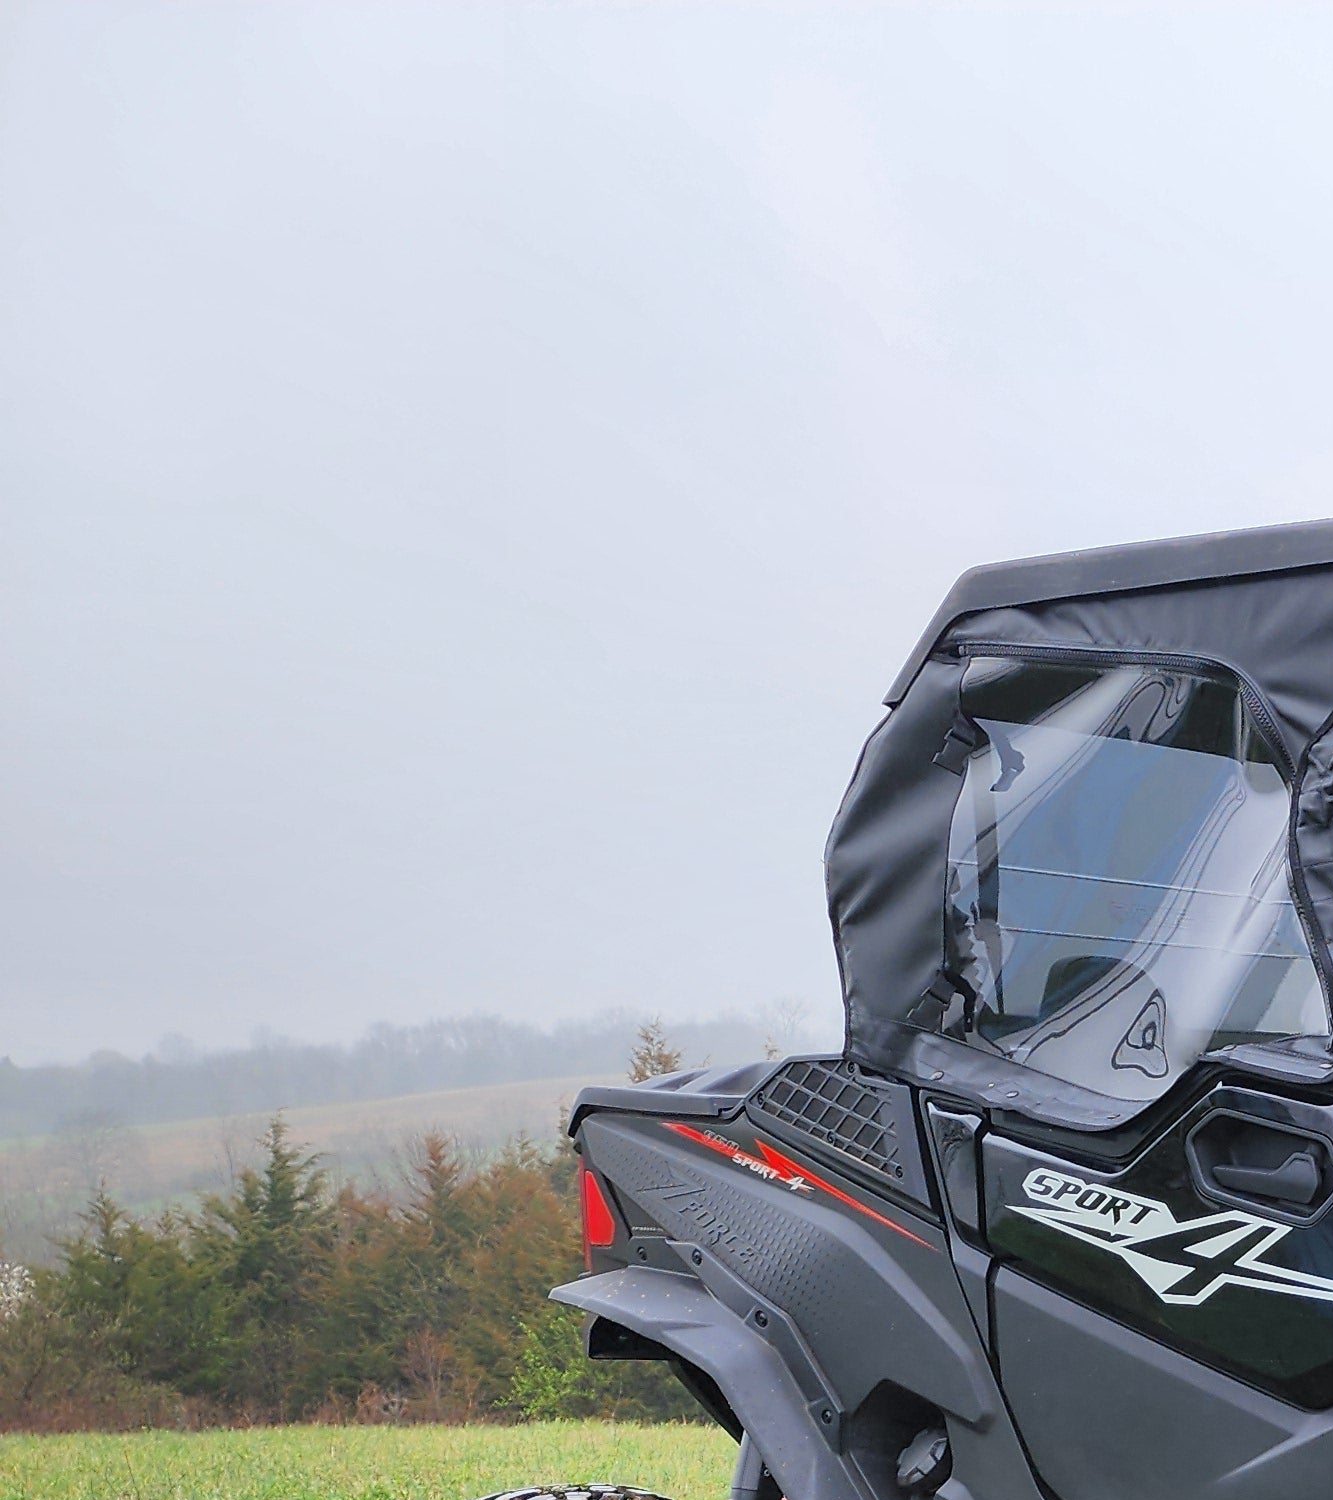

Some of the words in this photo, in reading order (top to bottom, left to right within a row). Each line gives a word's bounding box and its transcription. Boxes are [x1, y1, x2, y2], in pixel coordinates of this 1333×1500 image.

[731, 1152, 780, 1180] SPORT
[776, 1175, 816, 1192] 4
[1025, 1172, 1165, 1227] SPORT
